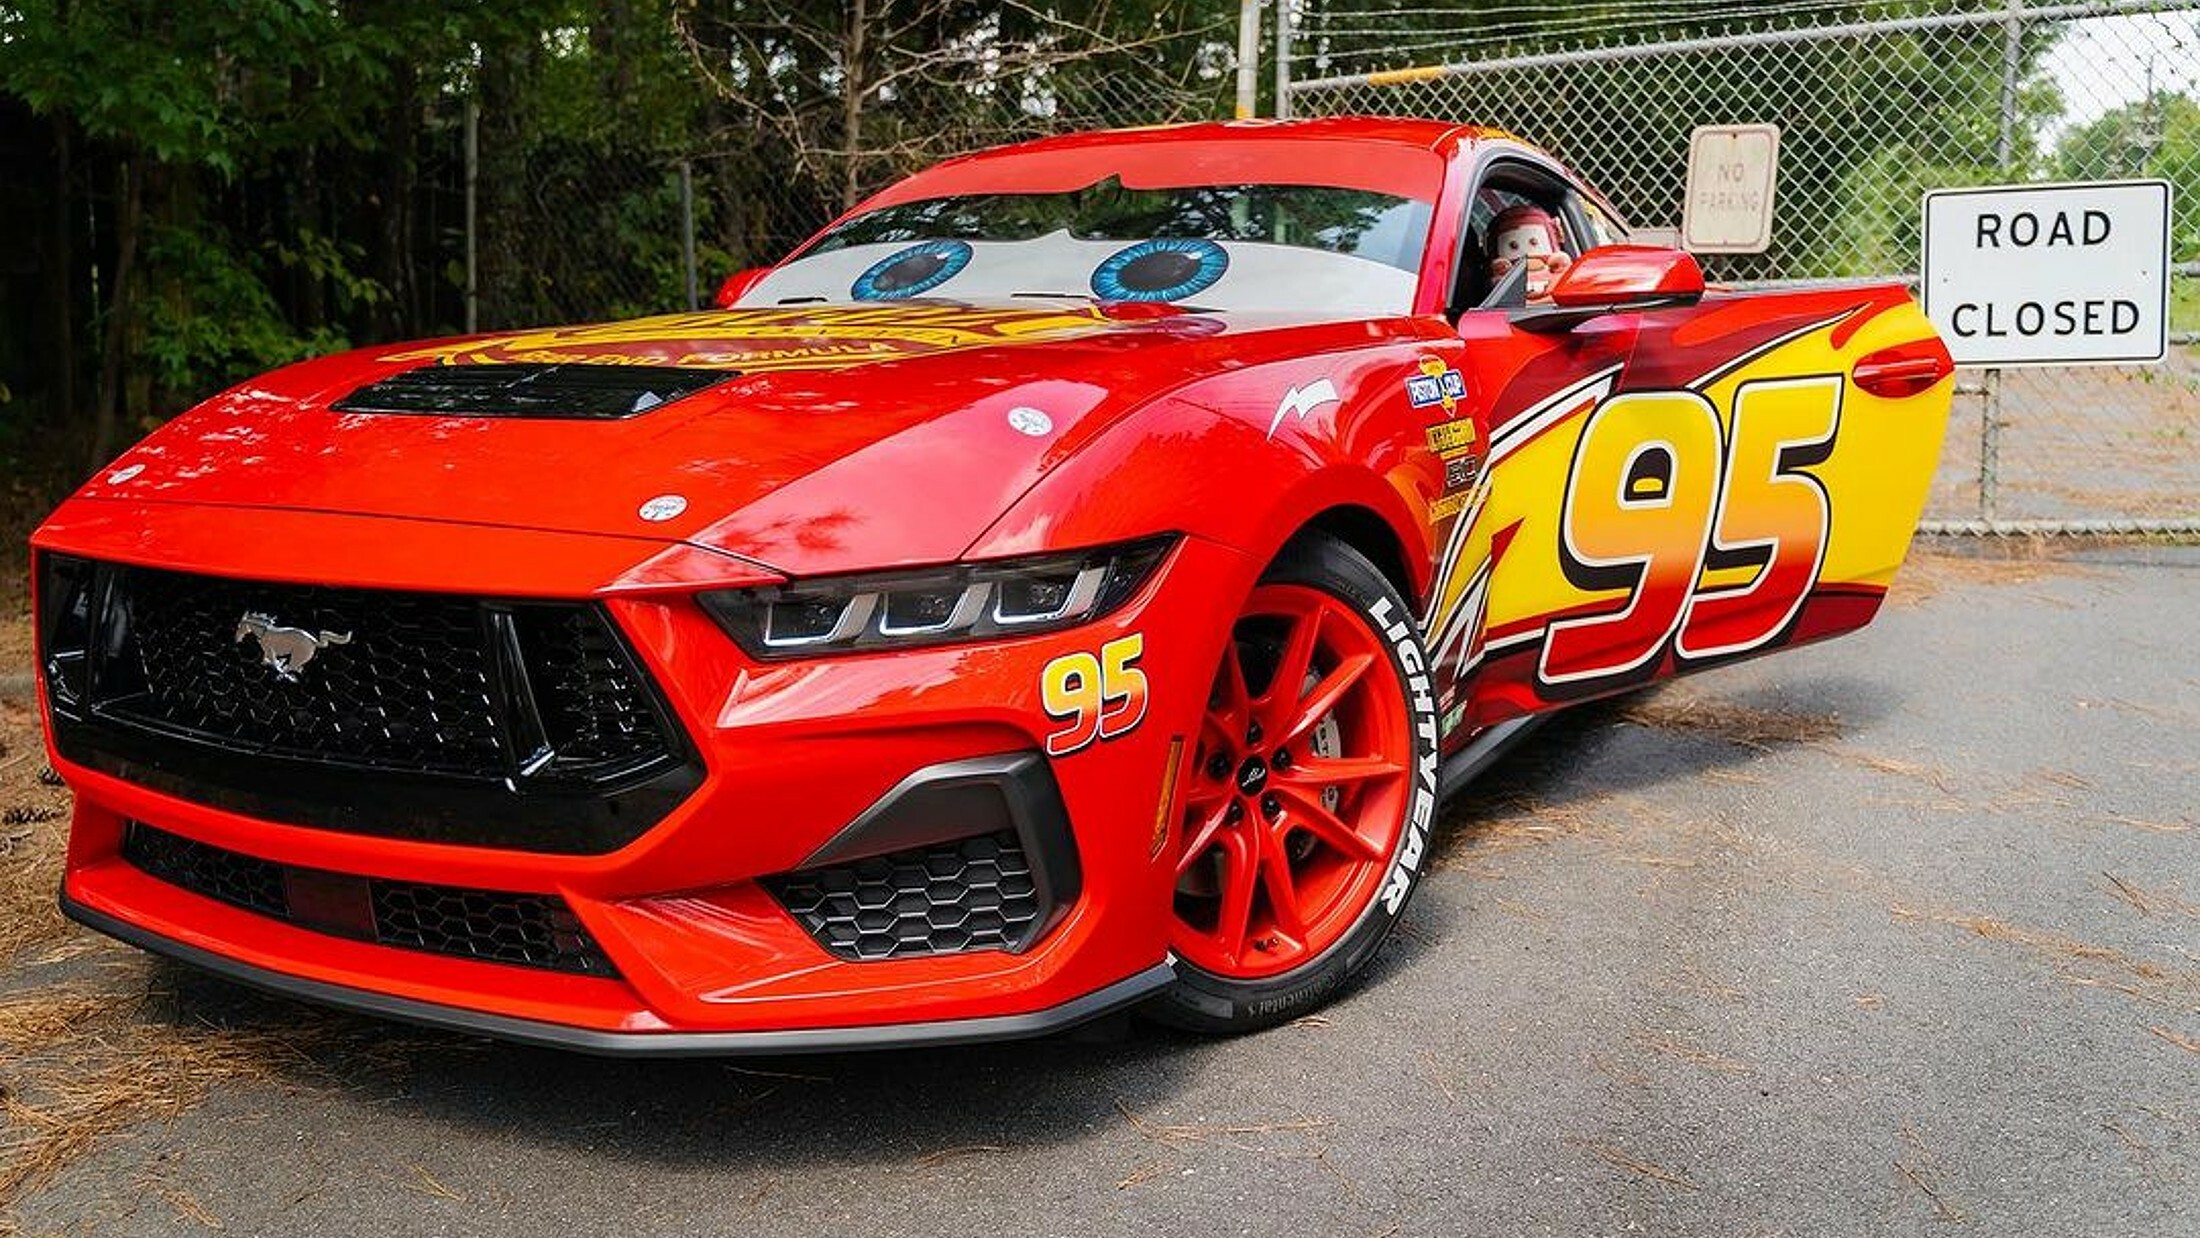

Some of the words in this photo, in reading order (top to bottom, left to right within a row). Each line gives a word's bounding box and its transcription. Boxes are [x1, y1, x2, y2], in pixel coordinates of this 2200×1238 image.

[1718, 163, 1744, 182] NO
[1976, 210, 2111, 248] ROAD
[1952, 300, 2140, 337] CLOSED
[677, 342, 898, 366] FORMULA
[1536, 374, 1844, 694] 95
[1042, 631, 1149, 757] 95
[1369, 596, 1437, 915] LIGHTYEAR
